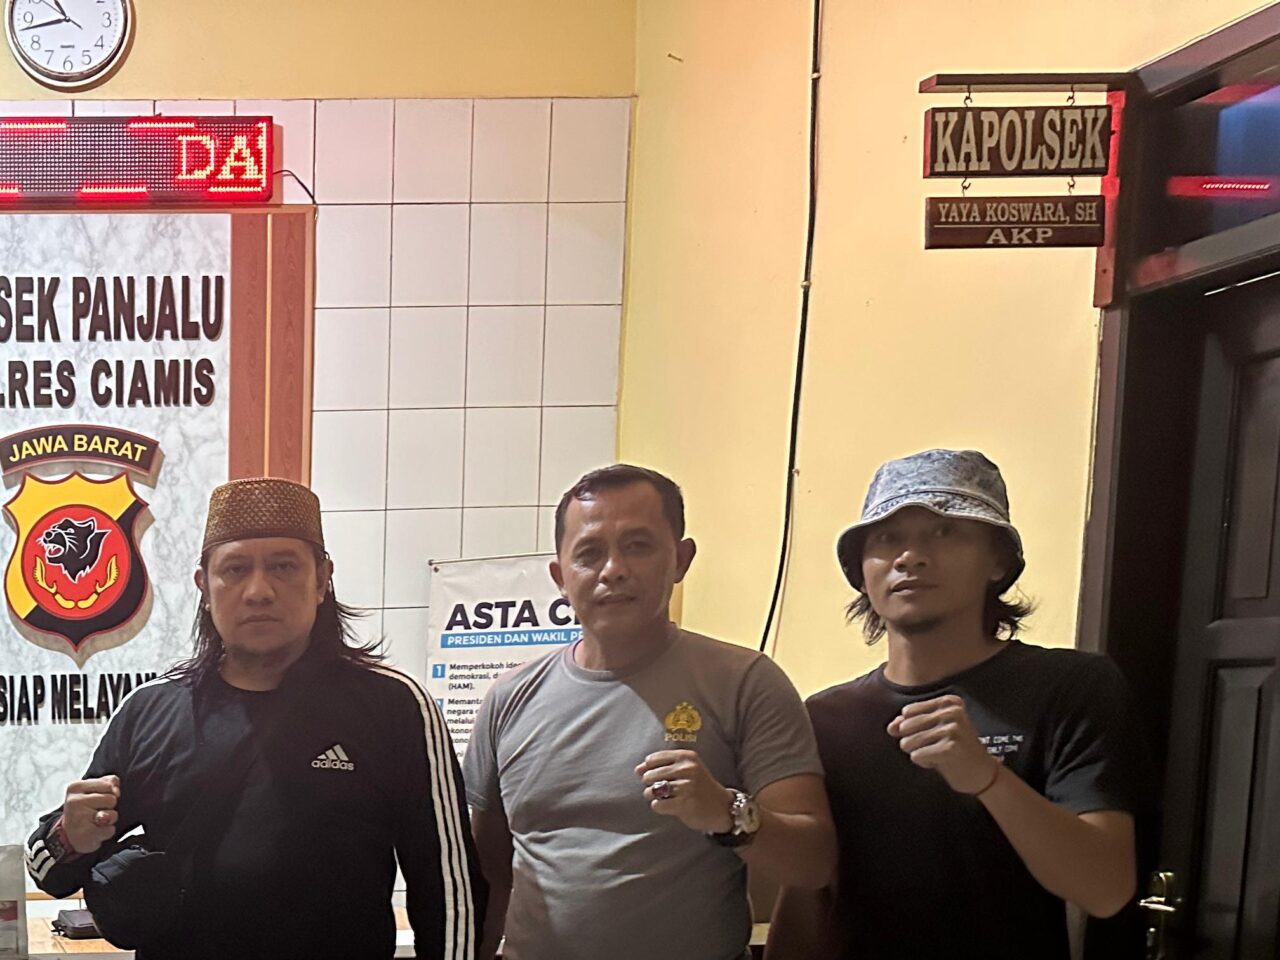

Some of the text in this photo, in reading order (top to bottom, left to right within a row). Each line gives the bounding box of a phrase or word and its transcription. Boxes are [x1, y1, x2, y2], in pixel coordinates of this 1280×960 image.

[23, 11, 34, 27] 9
[102, 11, 112, 28] 3
[30, 35, 41, 51] 8
[94, 35, 105, 50] 4
[44, 50, 55, 65] 7
[63, 55, 73, 71] 6
[81, 50, 92, 65] 5
[934, 109, 1108, 173] KAPOLSEK
[177, 134, 261, 181] DA
[939, 202, 1097, 225] YAYA KOSWARA, SH
[986, 228, 1053, 244] AKP
[72, 275, 225, 342] PANJALU
[91, 358, 216, 407] CIAMIS
[9, 434, 147, 463] JAWA BARAT
[445, 600, 540, 630] ASTA
[447, 634, 502, 646] PRESIDEN
[504, 633, 529, 644] DAN
[532, 631, 567, 642] WAKIL
[449, 663, 504, 671] Memperkokoh
[665, 733, 697, 742] POLISI
[311, 759, 354, 770] adidas
